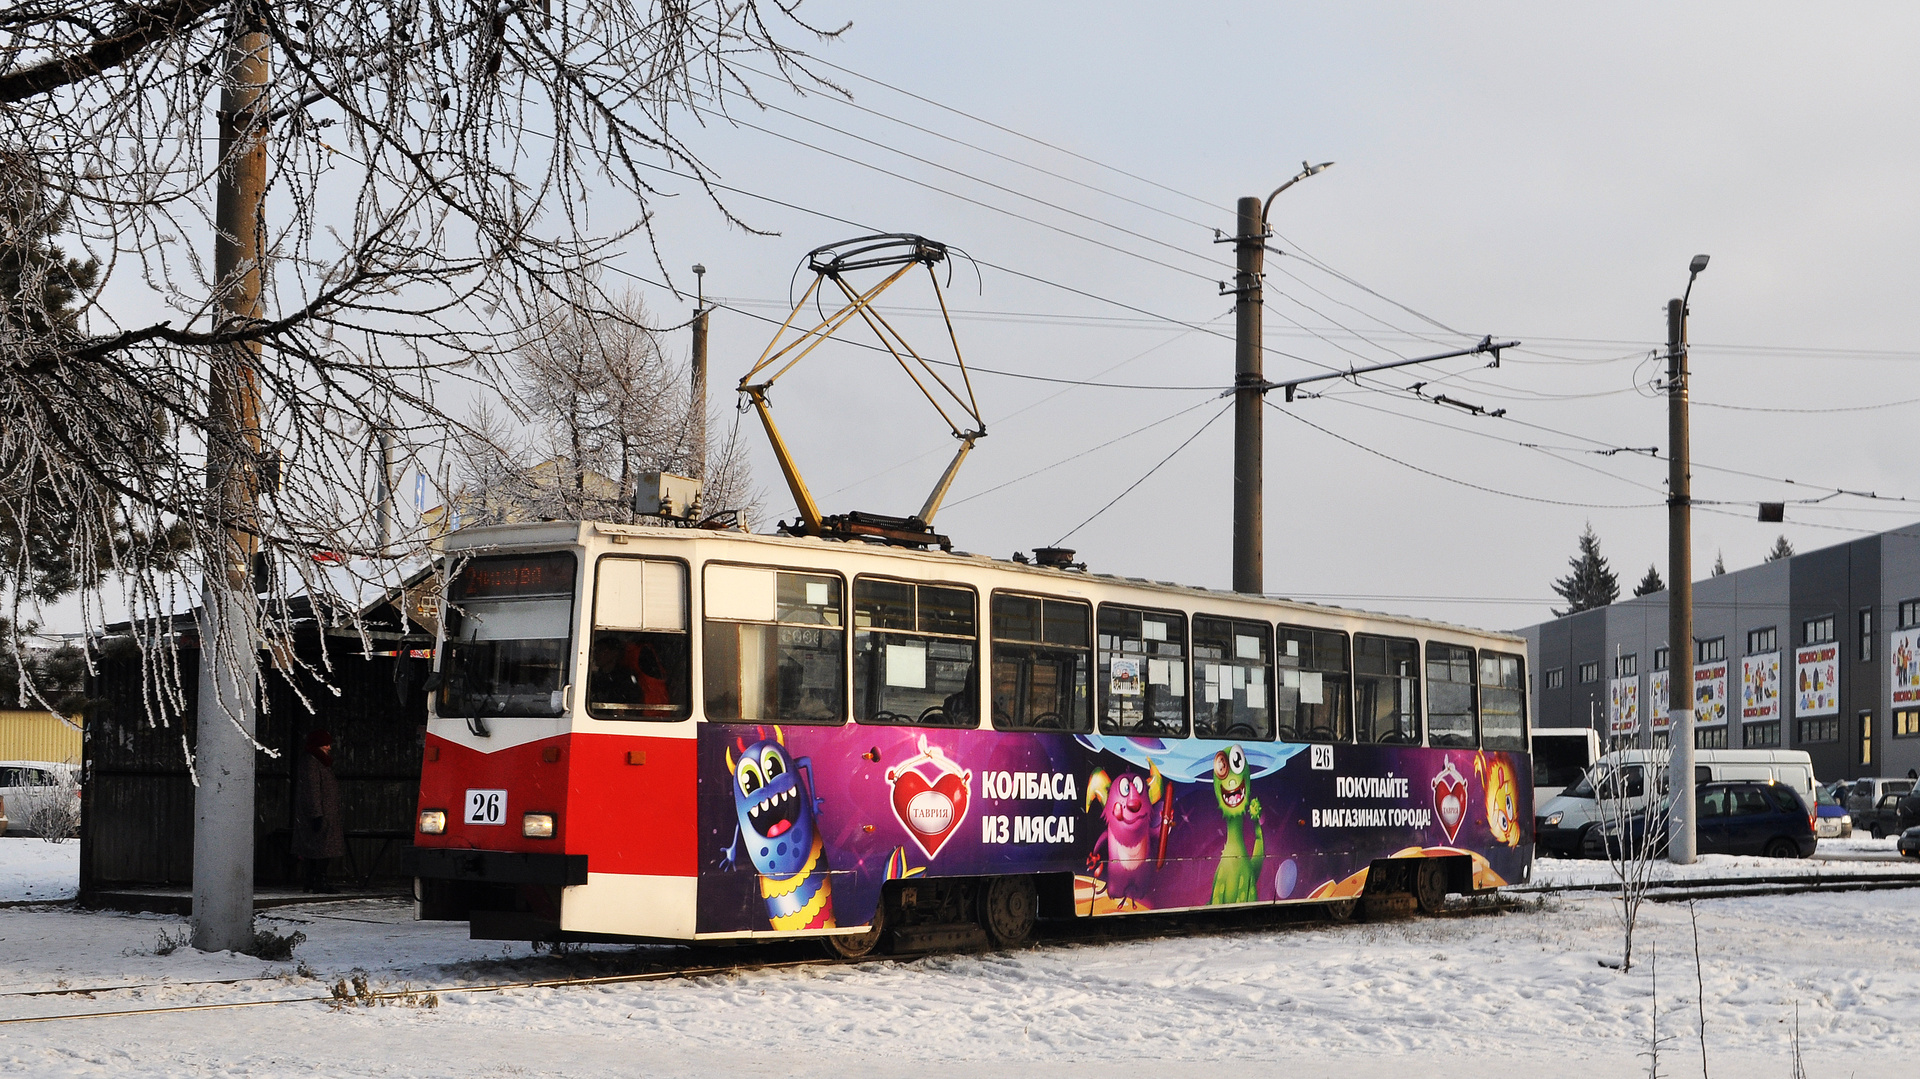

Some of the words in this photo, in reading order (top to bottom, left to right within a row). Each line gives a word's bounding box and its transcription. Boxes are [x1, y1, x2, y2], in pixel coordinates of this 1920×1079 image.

[1315, 748, 1331, 768] 26
[982, 770, 1077, 801] КОЛБАСА
[1336, 772, 1409, 798] ПОКУПАЙТЕ
[472, 793, 499, 823] 26
[912, 808, 948, 818] ТАВРИЯ
[1312, 808, 1320, 828] В
[1322, 808, 1387, 828] МАГАЗИНАХ
[1388, 808, 1431, 830] ГОРОДА!
[982, 815, 1010, 844] ИЗ
[1013, 815, 1075, 844] МЯСА!
